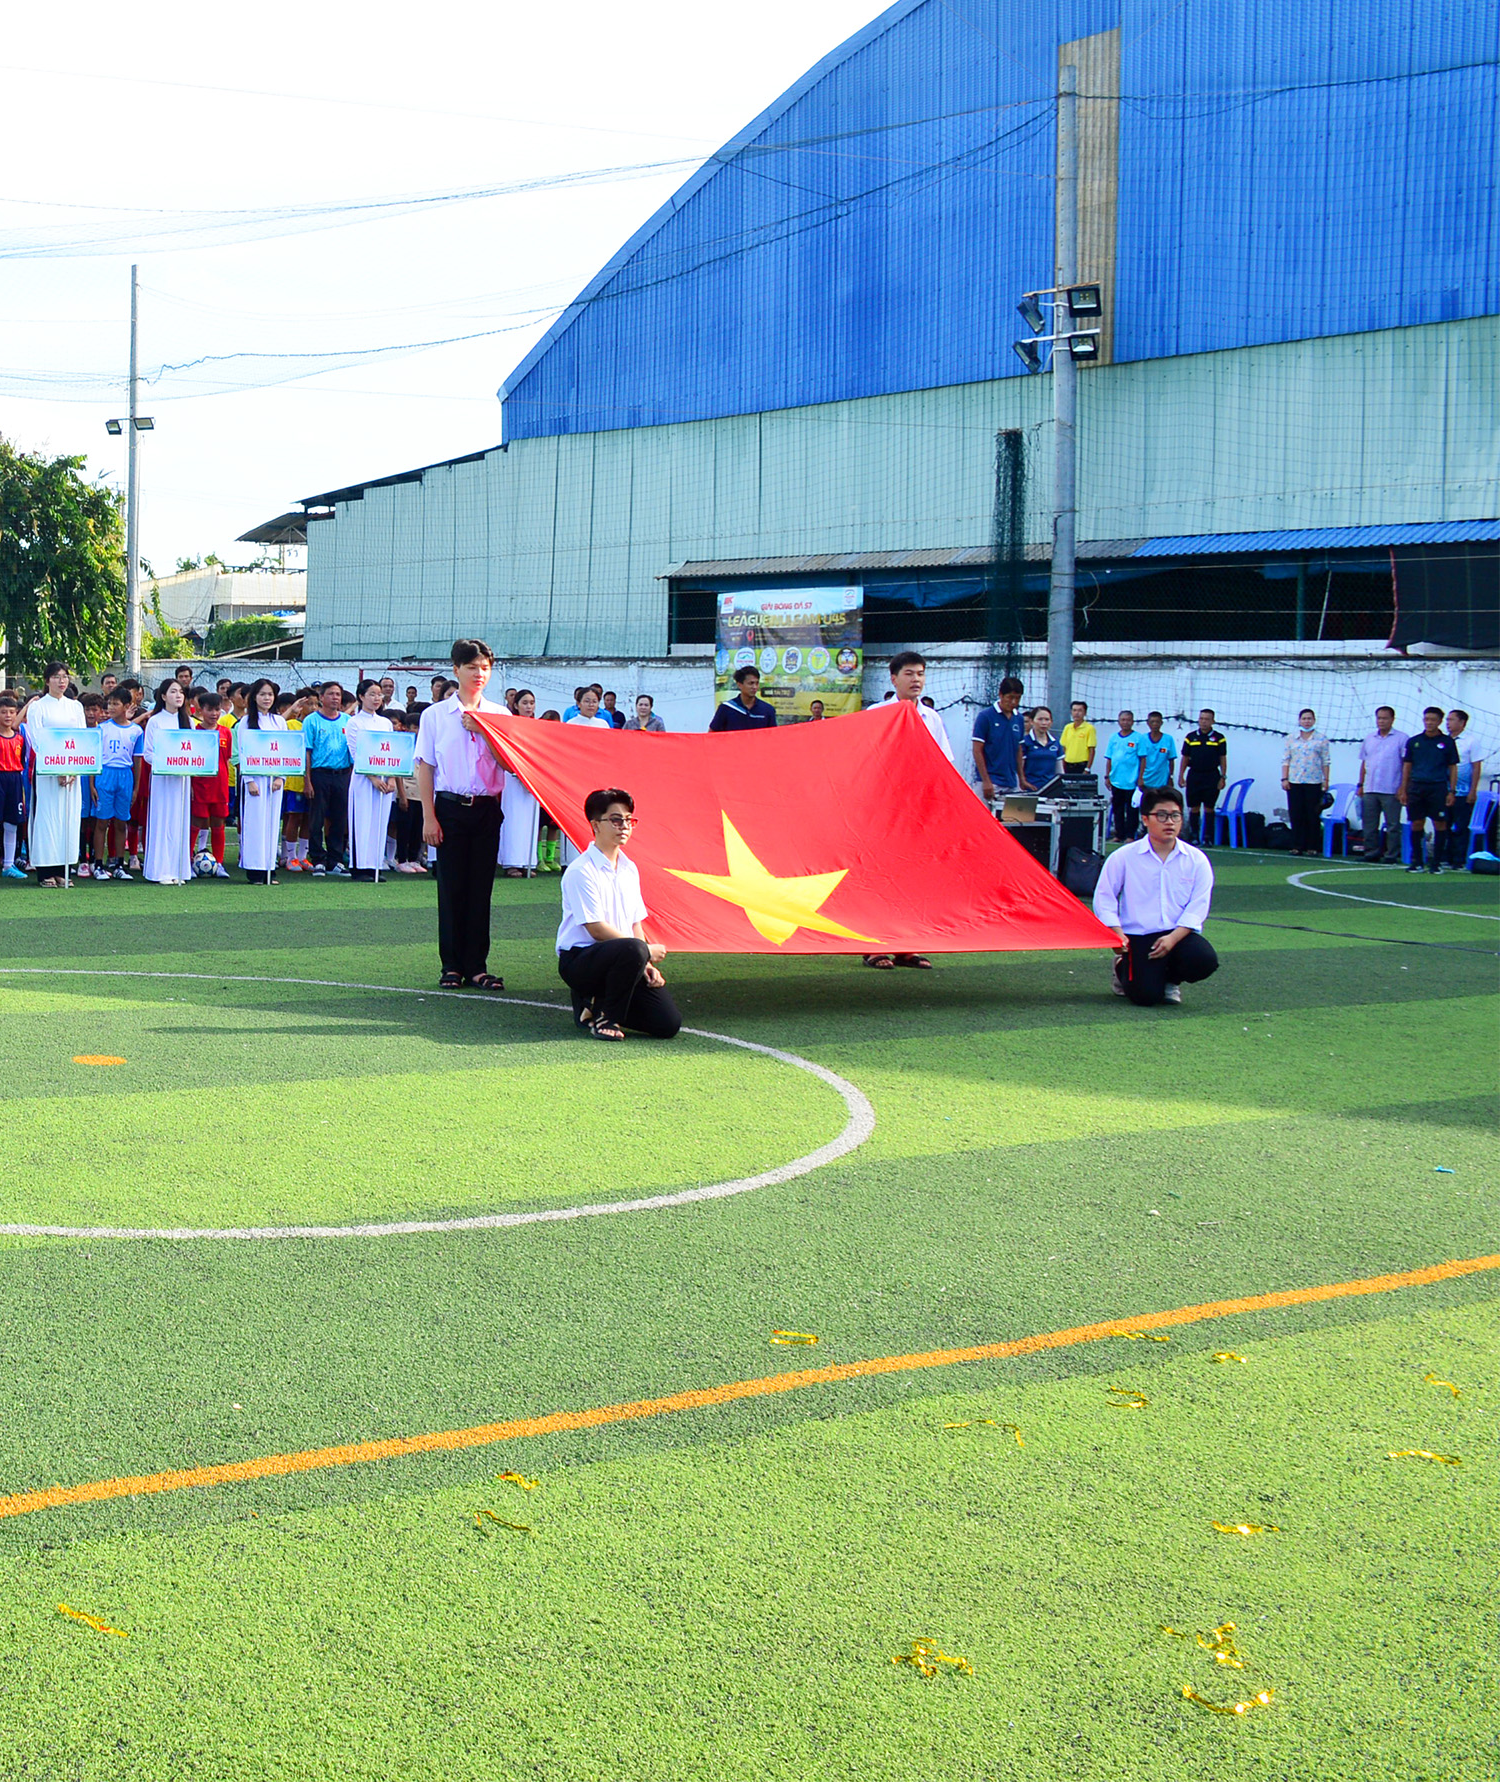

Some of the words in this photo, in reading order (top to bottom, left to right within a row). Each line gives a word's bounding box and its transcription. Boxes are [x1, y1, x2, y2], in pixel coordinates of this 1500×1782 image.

[64, 738, 76, 750] XÃ
[180, 740, 192, 751] XÃ
[270, 740, 279, 752] XÃ
[380, 741, 390, 752] XÃ
[44, 754, 66, 765] CHÂU
[68, 755, 95, 766] PHONG
[166, 756, 189, 767] NHƠN
[191, 755, 205, 769] HỘI
[261, 757, 281, 769] THẠNH
[282, 757, 301, 767] TRUNG
[368, 756, 386, 767] VĨNH
[387, 757, 401, 767] TUY
